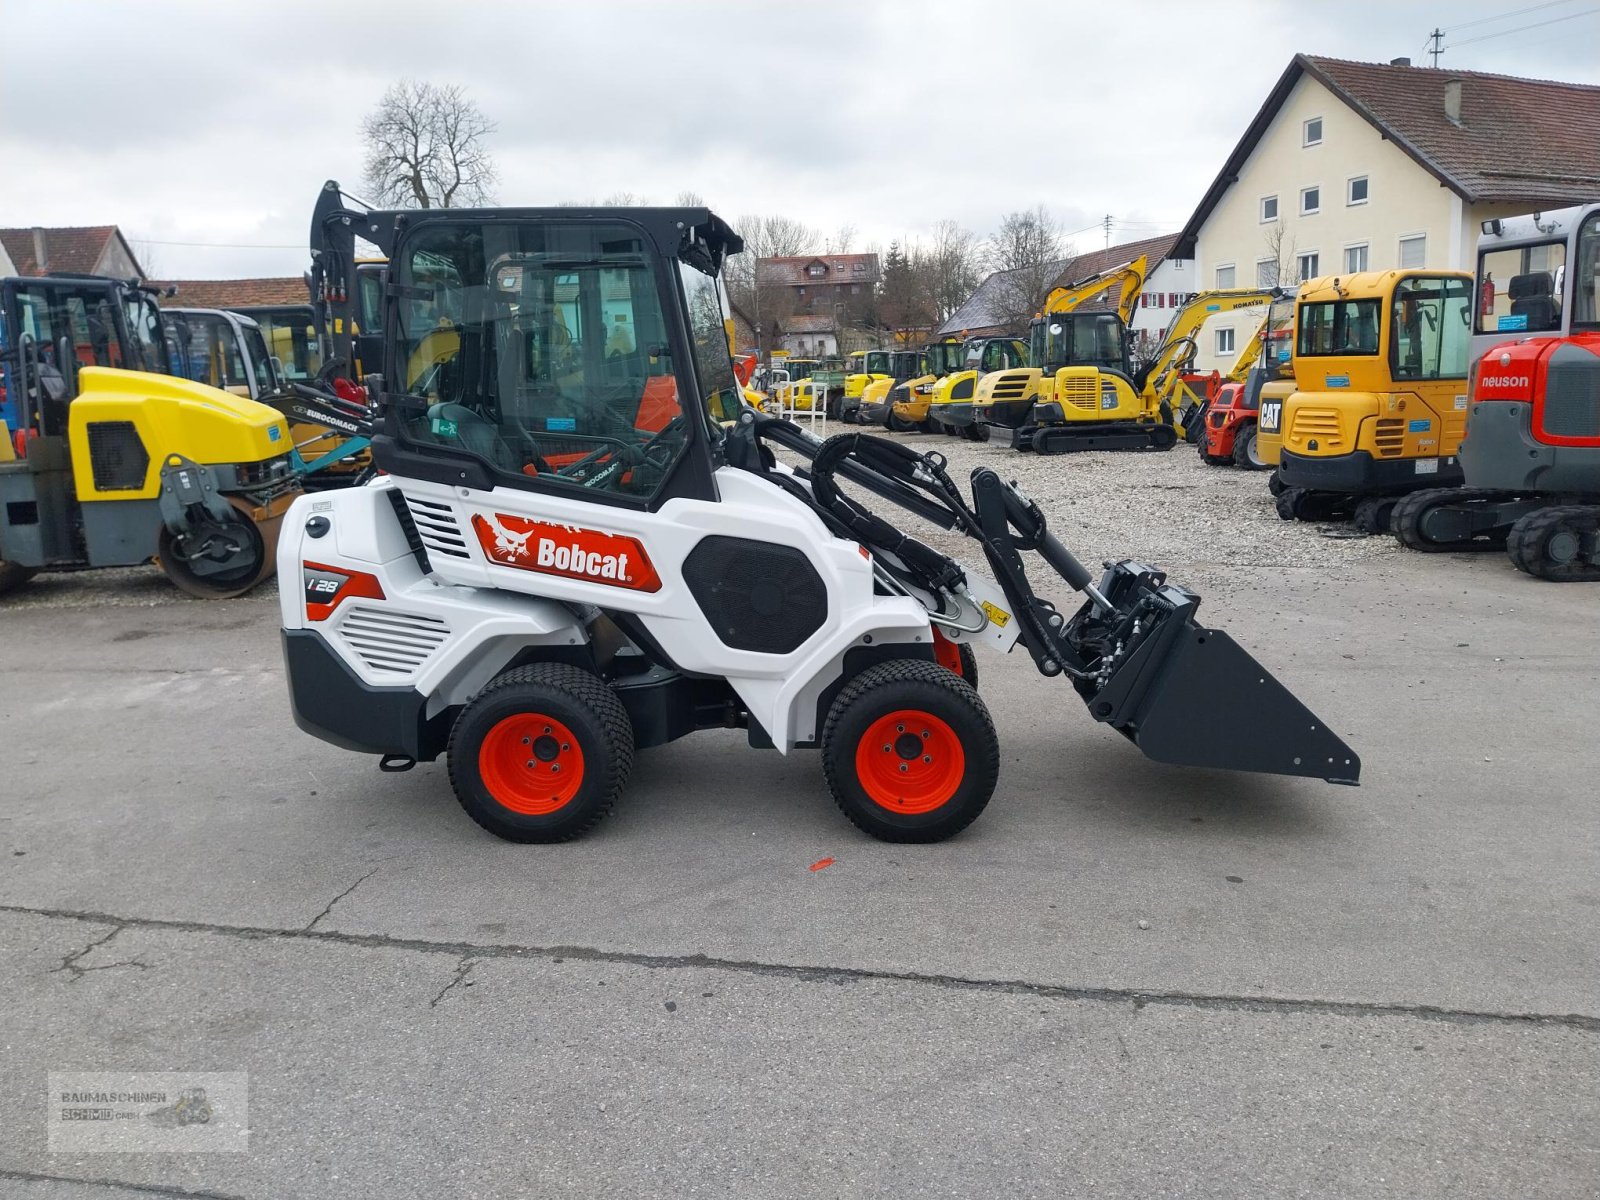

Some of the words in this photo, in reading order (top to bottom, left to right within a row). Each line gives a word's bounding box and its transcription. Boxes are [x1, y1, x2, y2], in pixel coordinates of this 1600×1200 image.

[1232, 299, 1264, 309] KOMATSU
[1482, 376, 1529, 388] neuson
[306, 408, 359, 433] EUROCOMACH
[1261, 402, 1281, 429] CAT
[537, 537, 628, 581] Bobcat
